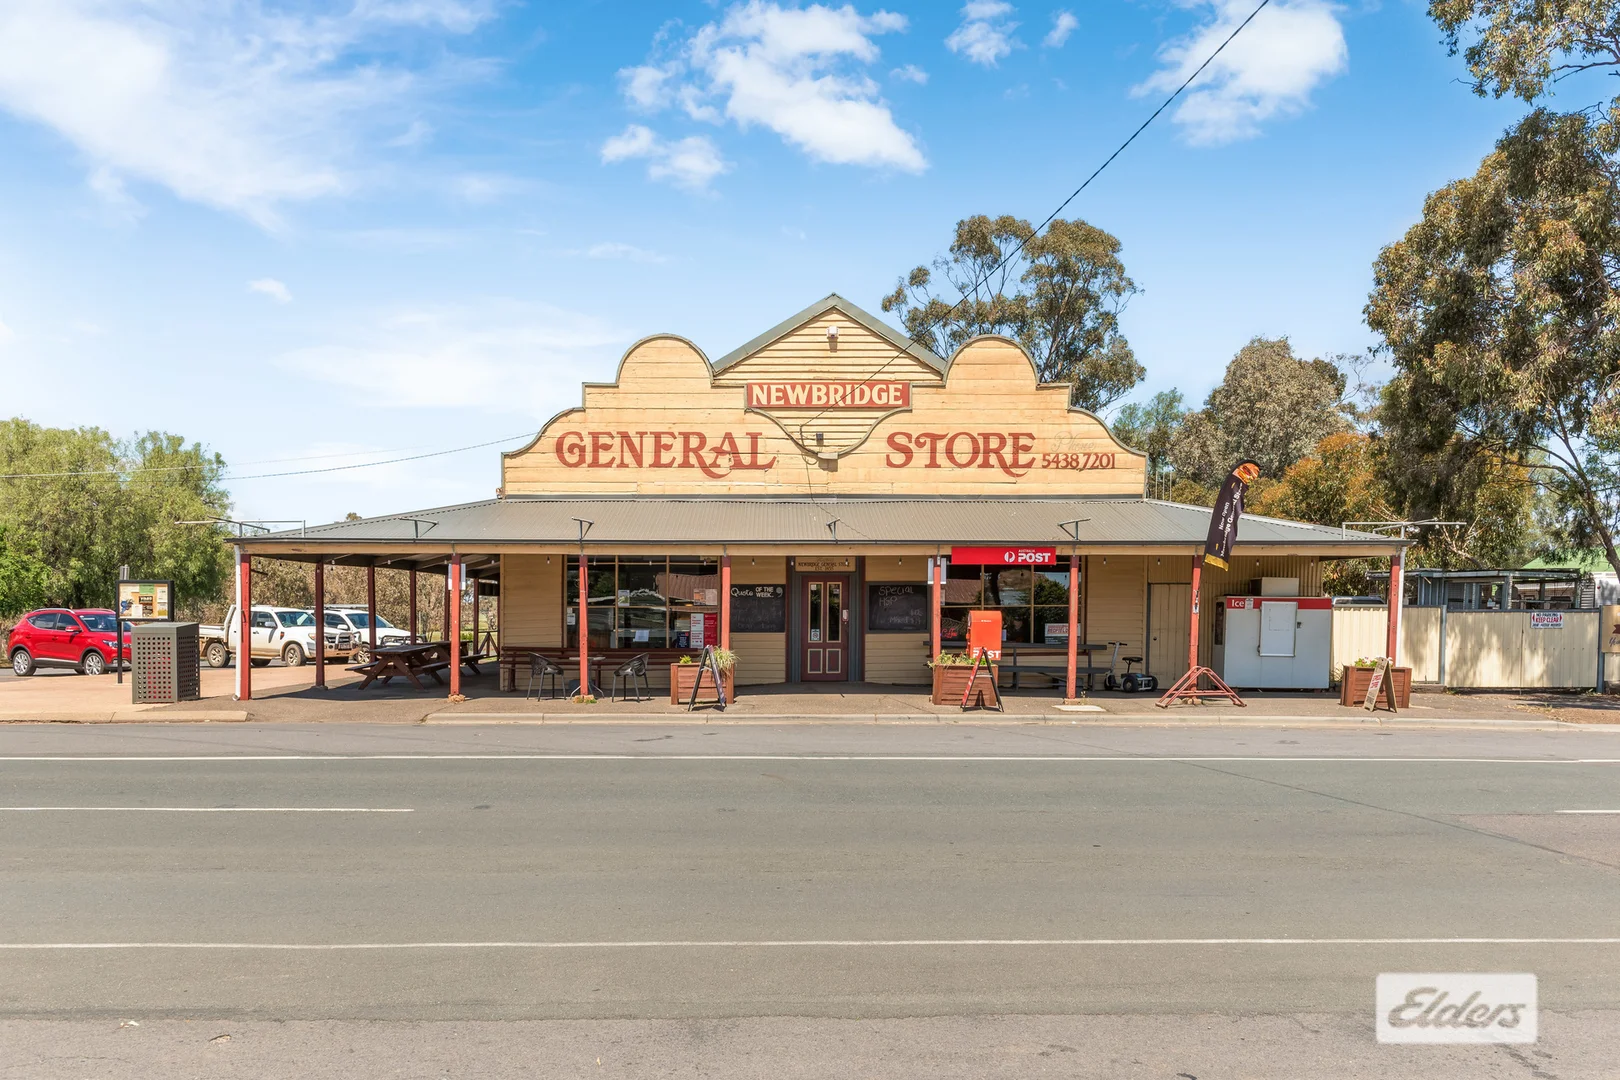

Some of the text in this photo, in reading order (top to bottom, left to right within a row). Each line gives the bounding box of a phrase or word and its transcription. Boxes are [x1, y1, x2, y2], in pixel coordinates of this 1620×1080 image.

[752, 384, 903, 406] NEWBRIDGE
[555, 431, 1037, 479] GENERAL STORE
[1018, 553, 1051, 562] POST
[972, 650, 1001, 659] PST
